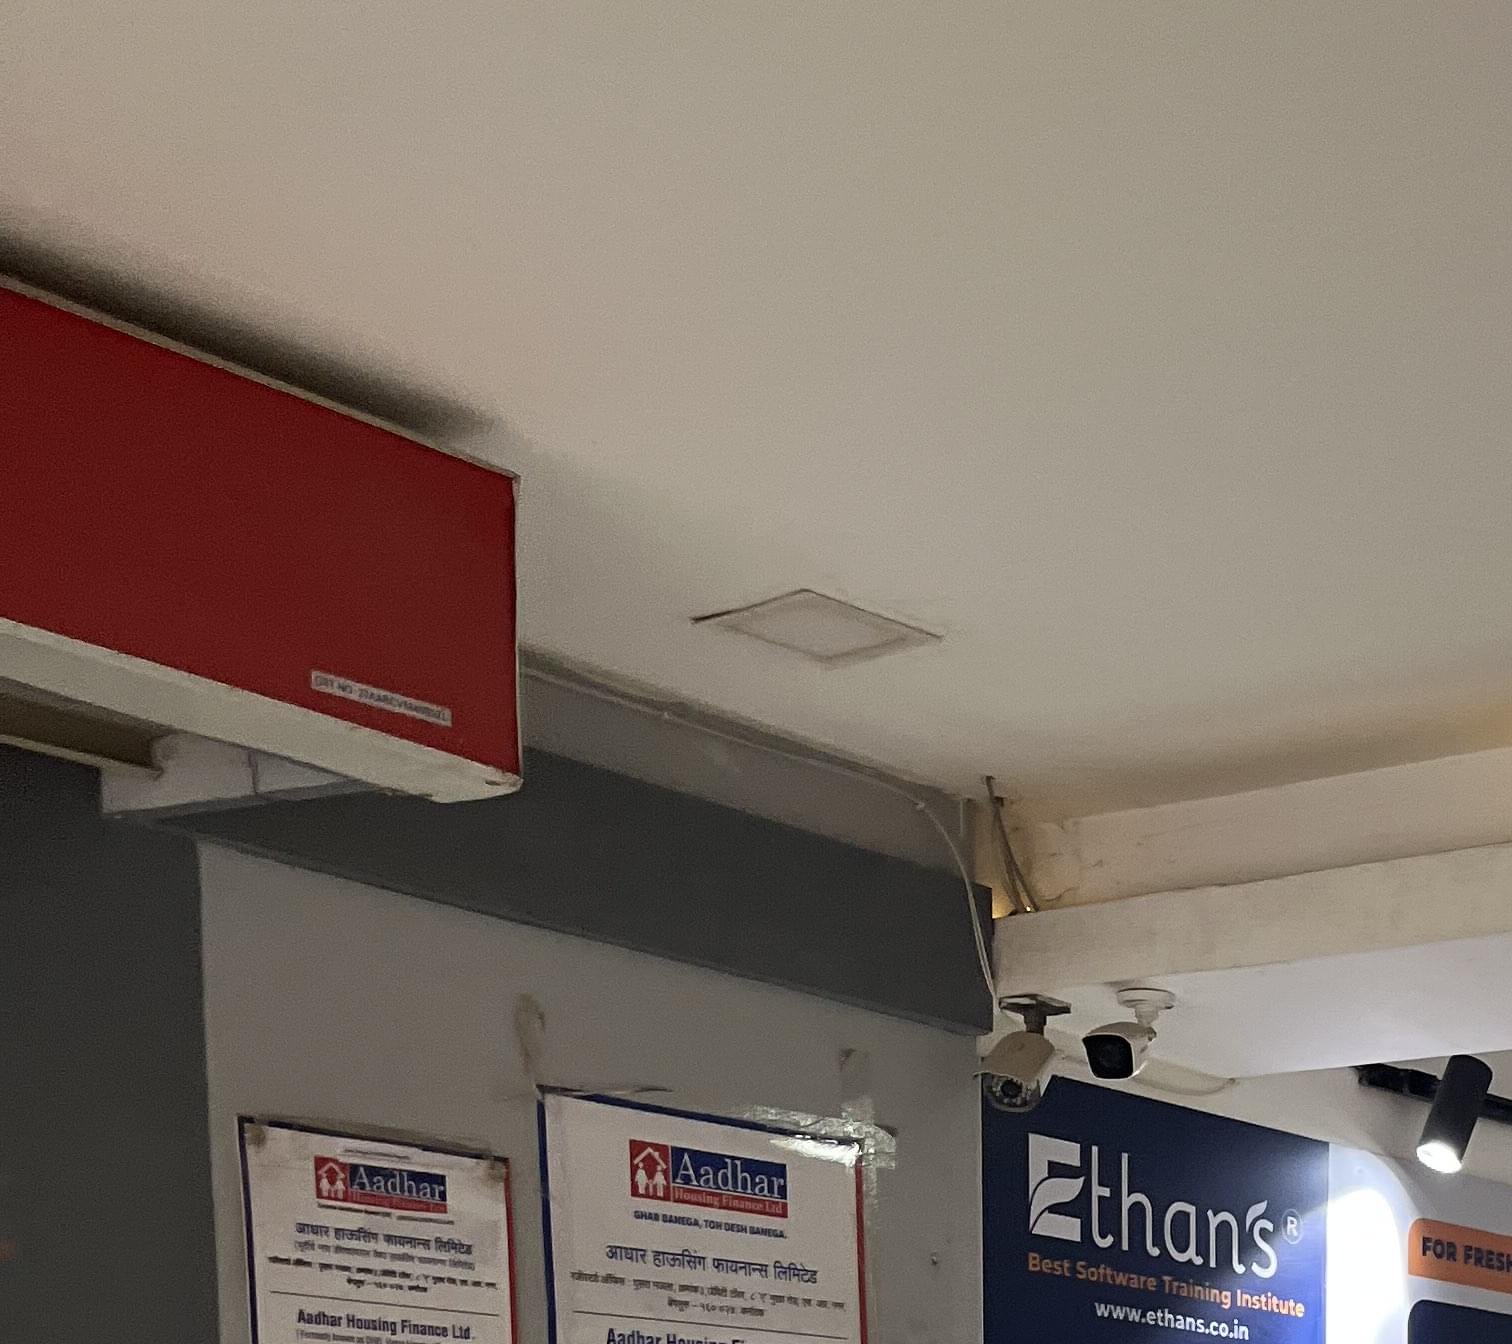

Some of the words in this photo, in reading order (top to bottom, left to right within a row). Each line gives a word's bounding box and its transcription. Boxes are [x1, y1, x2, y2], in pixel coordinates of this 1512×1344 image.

[353, 1166, 445, 1200] Aadhar
[675, 1152, 785, 1198] Aadhar
[674, 1188, 720, 1209] Housing
[723, 1193, 763, 1210] Finance
[295, 1222, 329, 1237] आधार
[435, 1237, 473, 1255] लिमिटेड
[1422, 1236, 1457, 1263] FOR
[606, 1245, 647, 1266] आधार
[651, 1249, 706, 1271] हाऊसिंग
[712, 1258, 768, 1280] फायनान्स
[773, 1261, 818, 1284] लिमिटेड
[1027, 1252, 1071, 1278] Best
[1076, 1261, 1157, 1291] Software
[1162, 1276, 1232, 1310] Training
[1236, 1290, 1305, 1318] Institute
[297, 1309, 342, 1327] Aadhar
[347, 1314, 396, 1335] Housing
[401, 1319, 448, 1337] Finance
[1095, 1301, 1250, 1341] www.ethans.co.in
